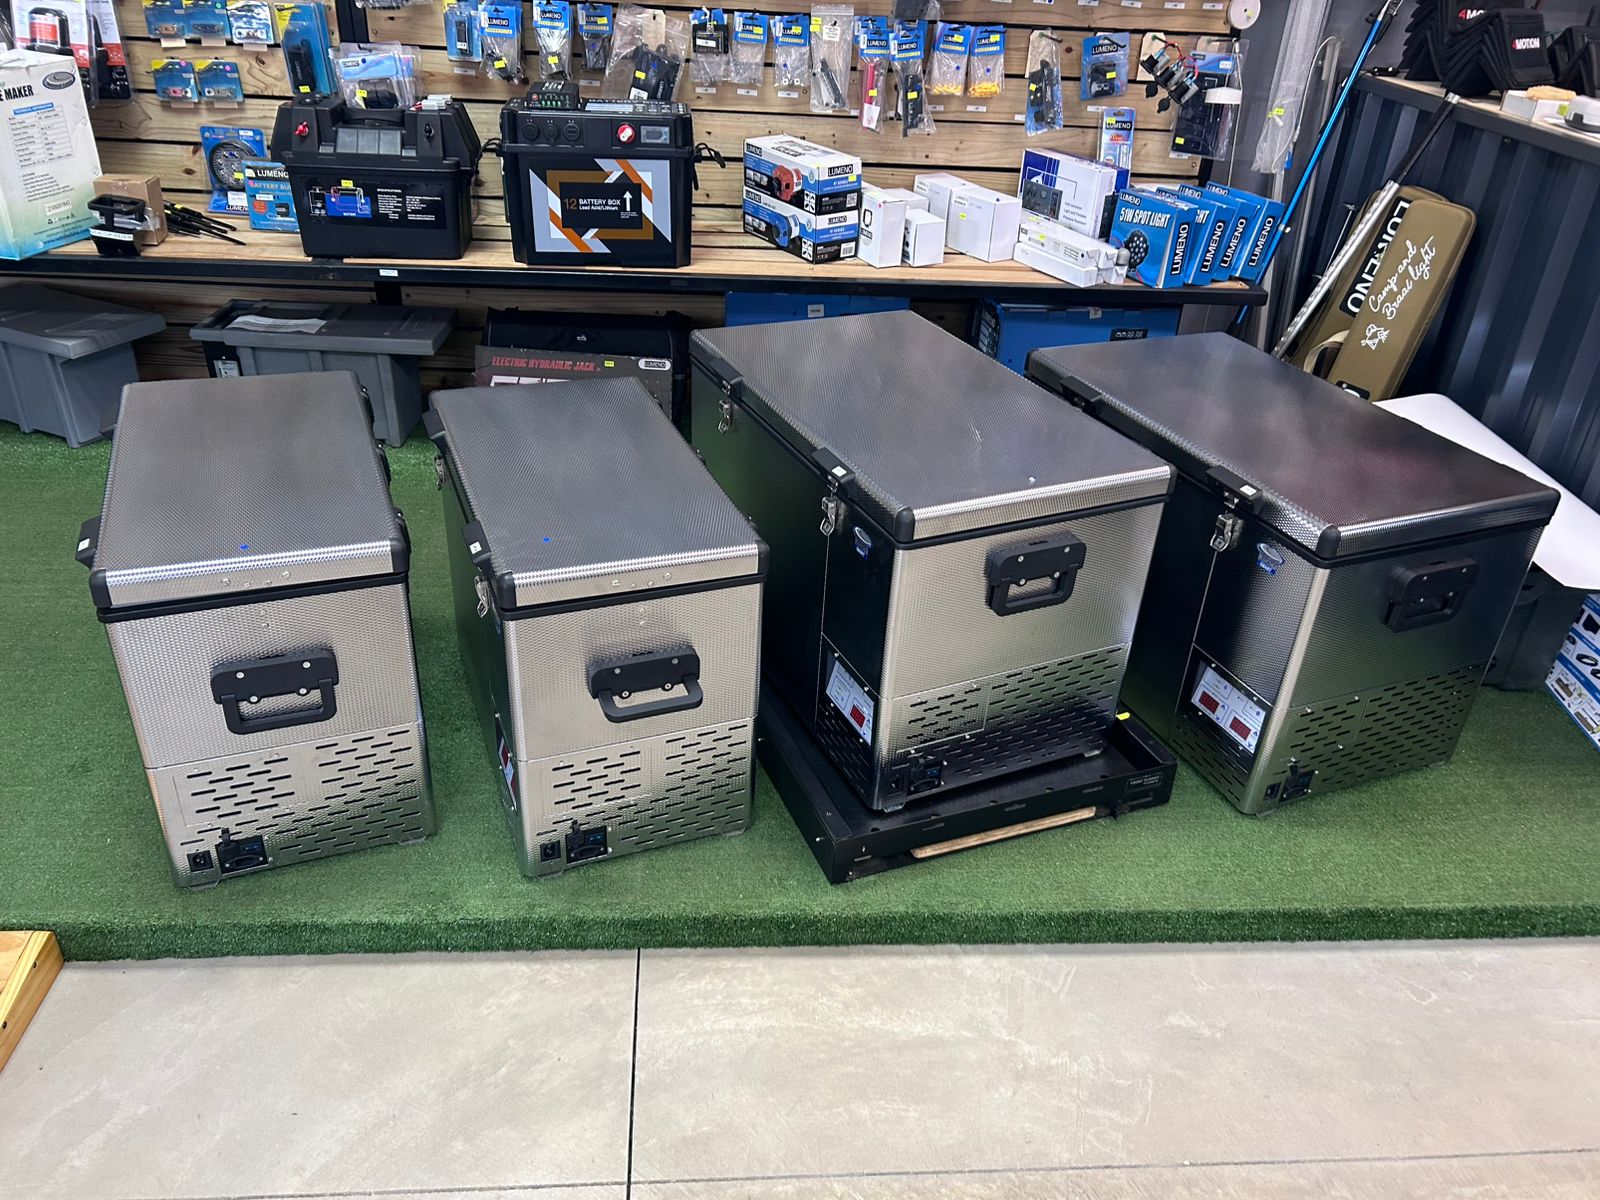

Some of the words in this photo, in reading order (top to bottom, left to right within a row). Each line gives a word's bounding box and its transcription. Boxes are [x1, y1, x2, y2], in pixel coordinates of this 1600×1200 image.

[541, 11, 562, 20] LUMENO
[898, 42, 917, 50] LUMENO
[1092, 44, 1118, 54] LUMENO
[1512, 37, 1540, 50] 4MOTION
[4, 84, 34, 101] MAKER
[1106, 121, 1131, 130] LUMENO
[829, 165, 853, 177] LUMENO
[1180, 186, 1202, 199] LUMENO
[1207, 184, 1228, 197] LUMENO
[564, 198, 577, 210] 12
[1120, 192, 1141, 206] LUMENO
[829, 215, 847, 225] LUMENO
[1120, 207, 1134, 223] 51W
[1134, 209, 1150, 225] SPOT
[1149, 211, 1171, 228] LIGHT
[1201, 222, 1225, 272] LUMENO
[1220, 218, 1246, 268] LUMENO
[1249, 217, 1274, 266] LUMENO
[1171, 224, 1189, 275] LUMENO
[1368, 273, 1398, 313] Camp
[1397, 239, 1418, 274] and
[1382, 280, 1413, 320] Braai
[1409, 235, 1436, 280] light
[492, 356, 528, 368] ELECTRIC
[528, 358, 572, 371] HYDRAULIC
[573, 360, 595, 372] JACK
[644, 361, 667, 369] LUMENO
